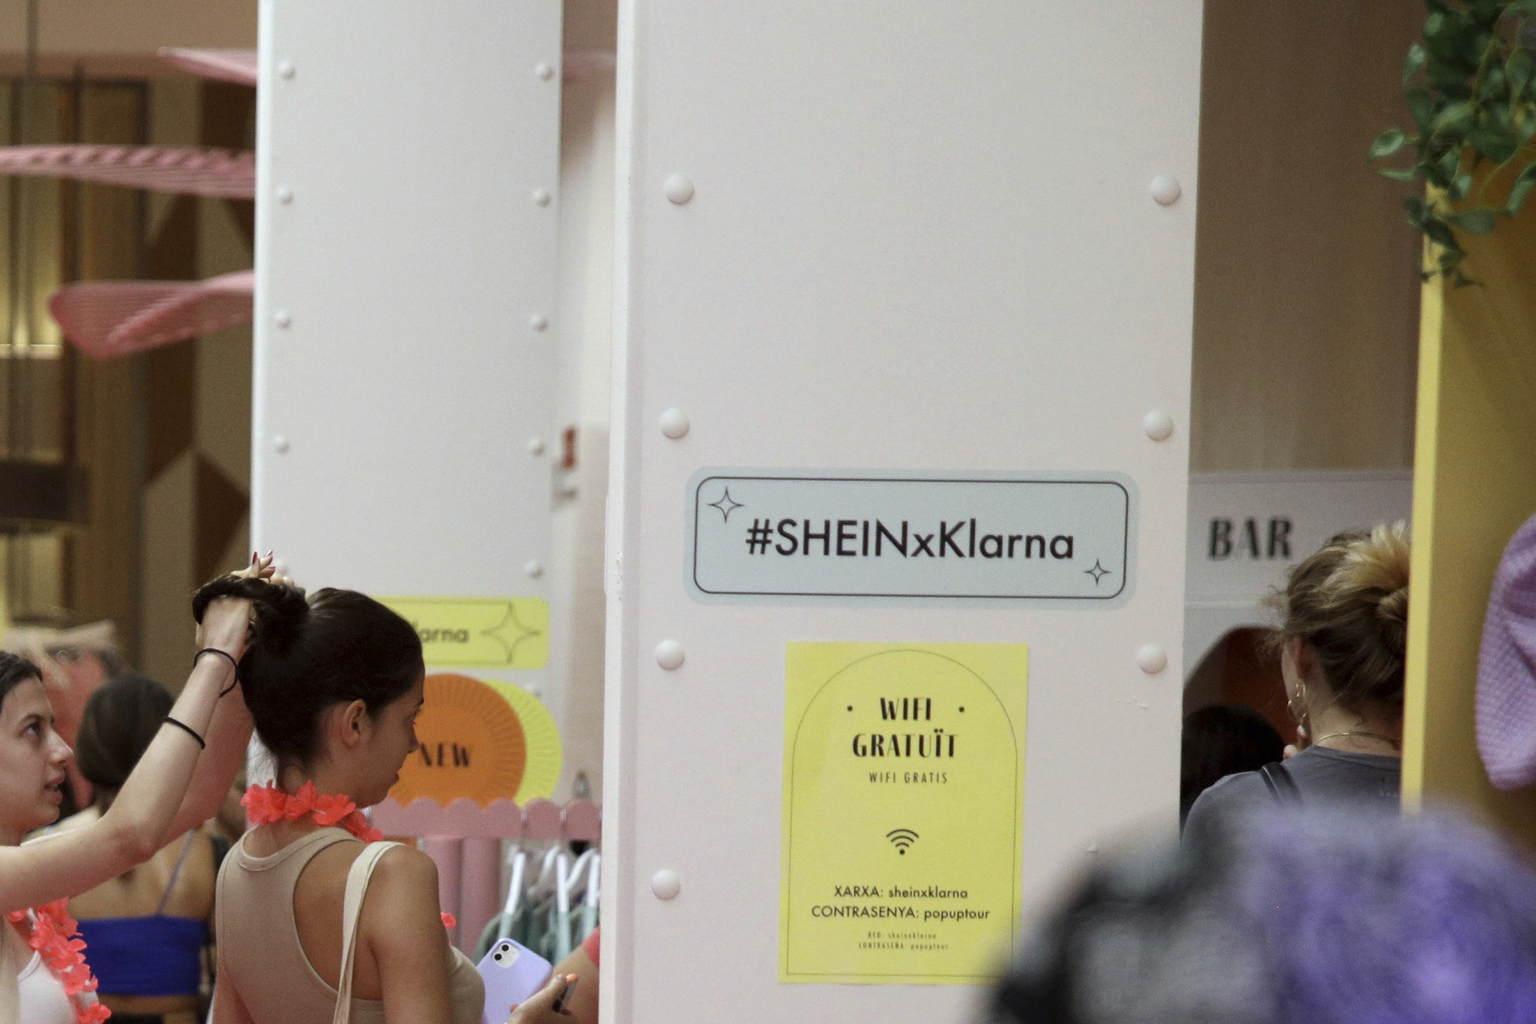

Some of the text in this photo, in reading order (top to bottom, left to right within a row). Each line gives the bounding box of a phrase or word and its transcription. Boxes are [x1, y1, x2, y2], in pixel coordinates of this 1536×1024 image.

[745, 517, 1074, 560] #SHEINxKlarna
[1208, 516, 1294, 560] BAR
[414, 620, 470, 644] arna
[879, 697, 932, 721] WIFI
[418, 742, 471, 768] NEW
[852, 728, 959, 758] GRATUÏT
[868, 771, 948, 785] WIFI GRATIS
[833, 885, 968, 899] XARXA: sheinxklarna
[811, 905, 990, 923] CONTRASENYA: popuptour
